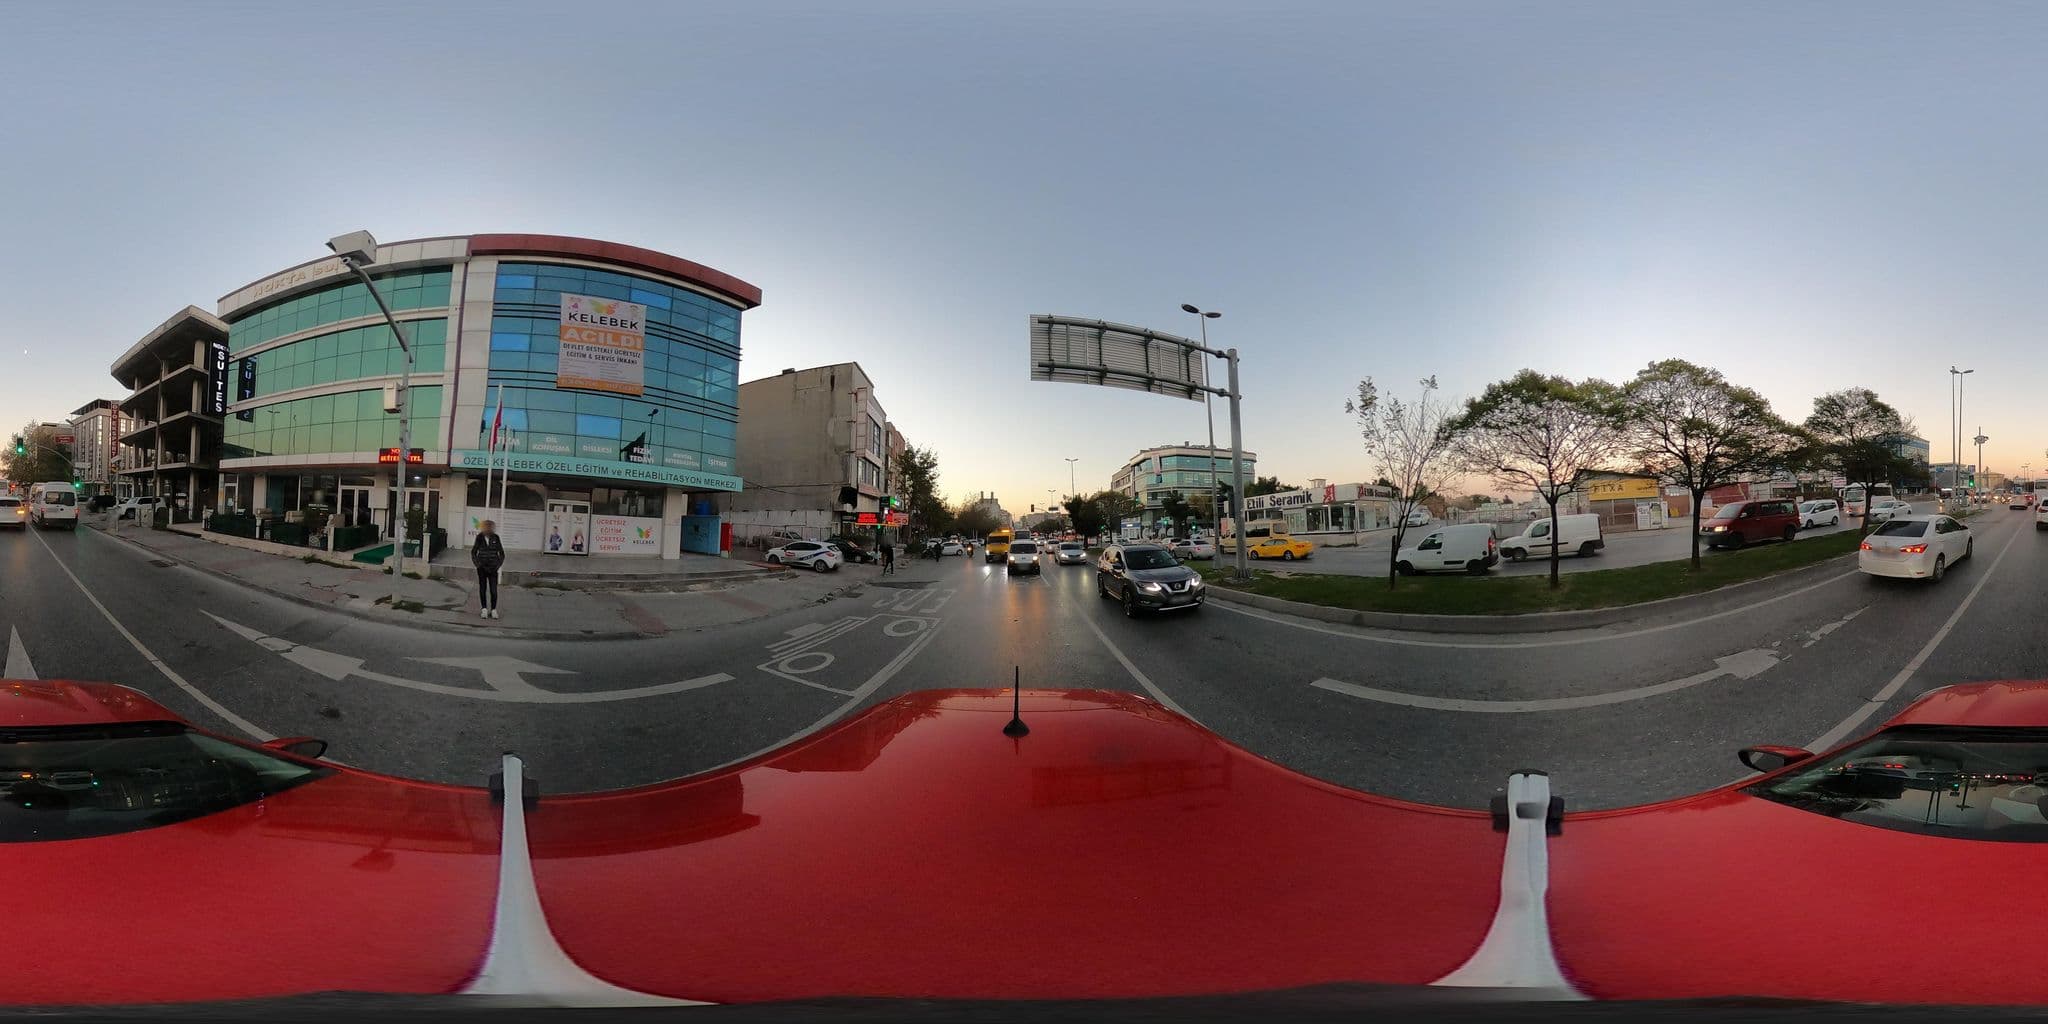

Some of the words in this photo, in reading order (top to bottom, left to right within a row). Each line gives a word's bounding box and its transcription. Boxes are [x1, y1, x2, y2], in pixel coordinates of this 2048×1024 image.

[568, 312, 639, 330] KELEBEK
[215, 351, 225, 412] SUITES
[493, 457, 543, 470] KELEBEK
[545, 459, 572, 472] ÖZEL
[624, 468, 702, 484] REHABİLİTASYON
[1269, 491, 1313, 507] Seramik
